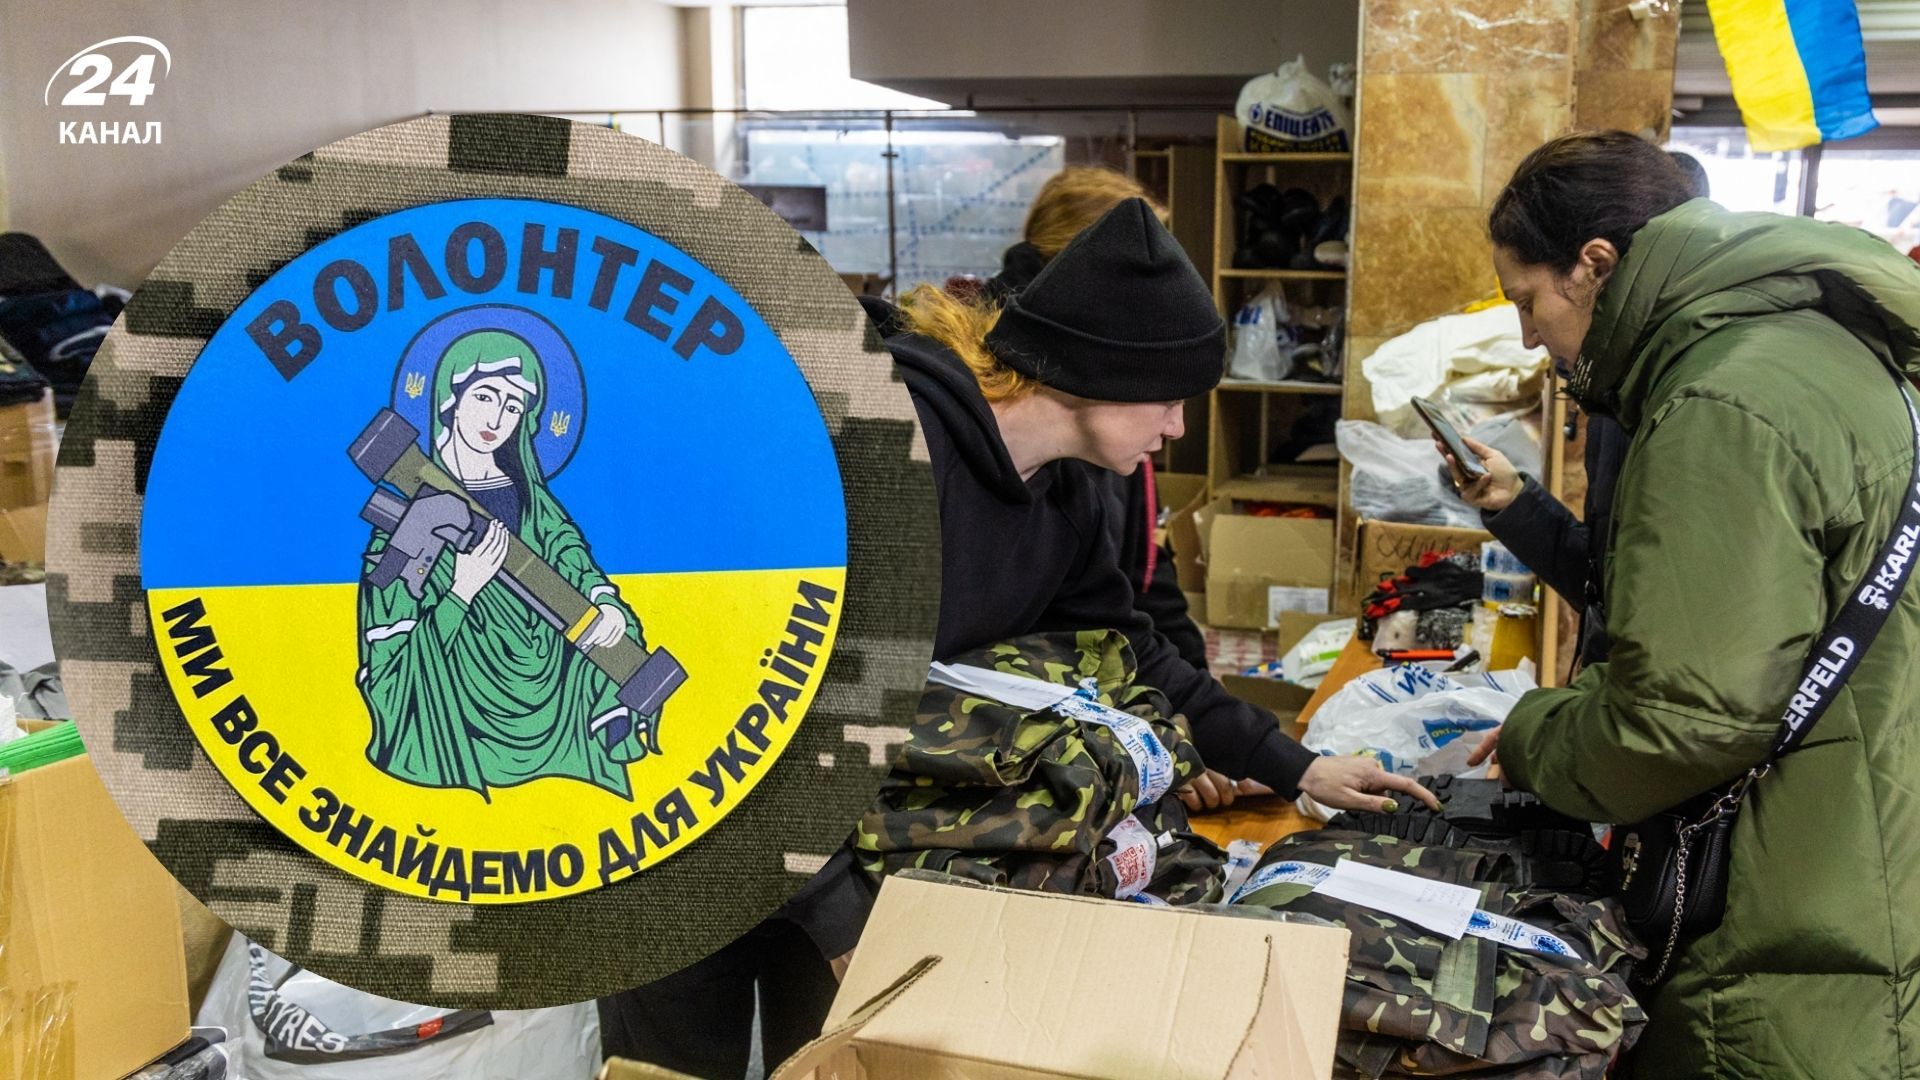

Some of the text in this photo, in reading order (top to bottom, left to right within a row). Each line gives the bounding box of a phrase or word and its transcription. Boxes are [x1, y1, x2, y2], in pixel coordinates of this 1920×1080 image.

[246, 222, 744, 382] ВОЛОНТЕР
[1874, 524, 1920, 591] KARL
[162, 580, 837, 901] МИ ВСЕ ЗНАЙДЕМО ДЛЯ УКРАЇНИ
